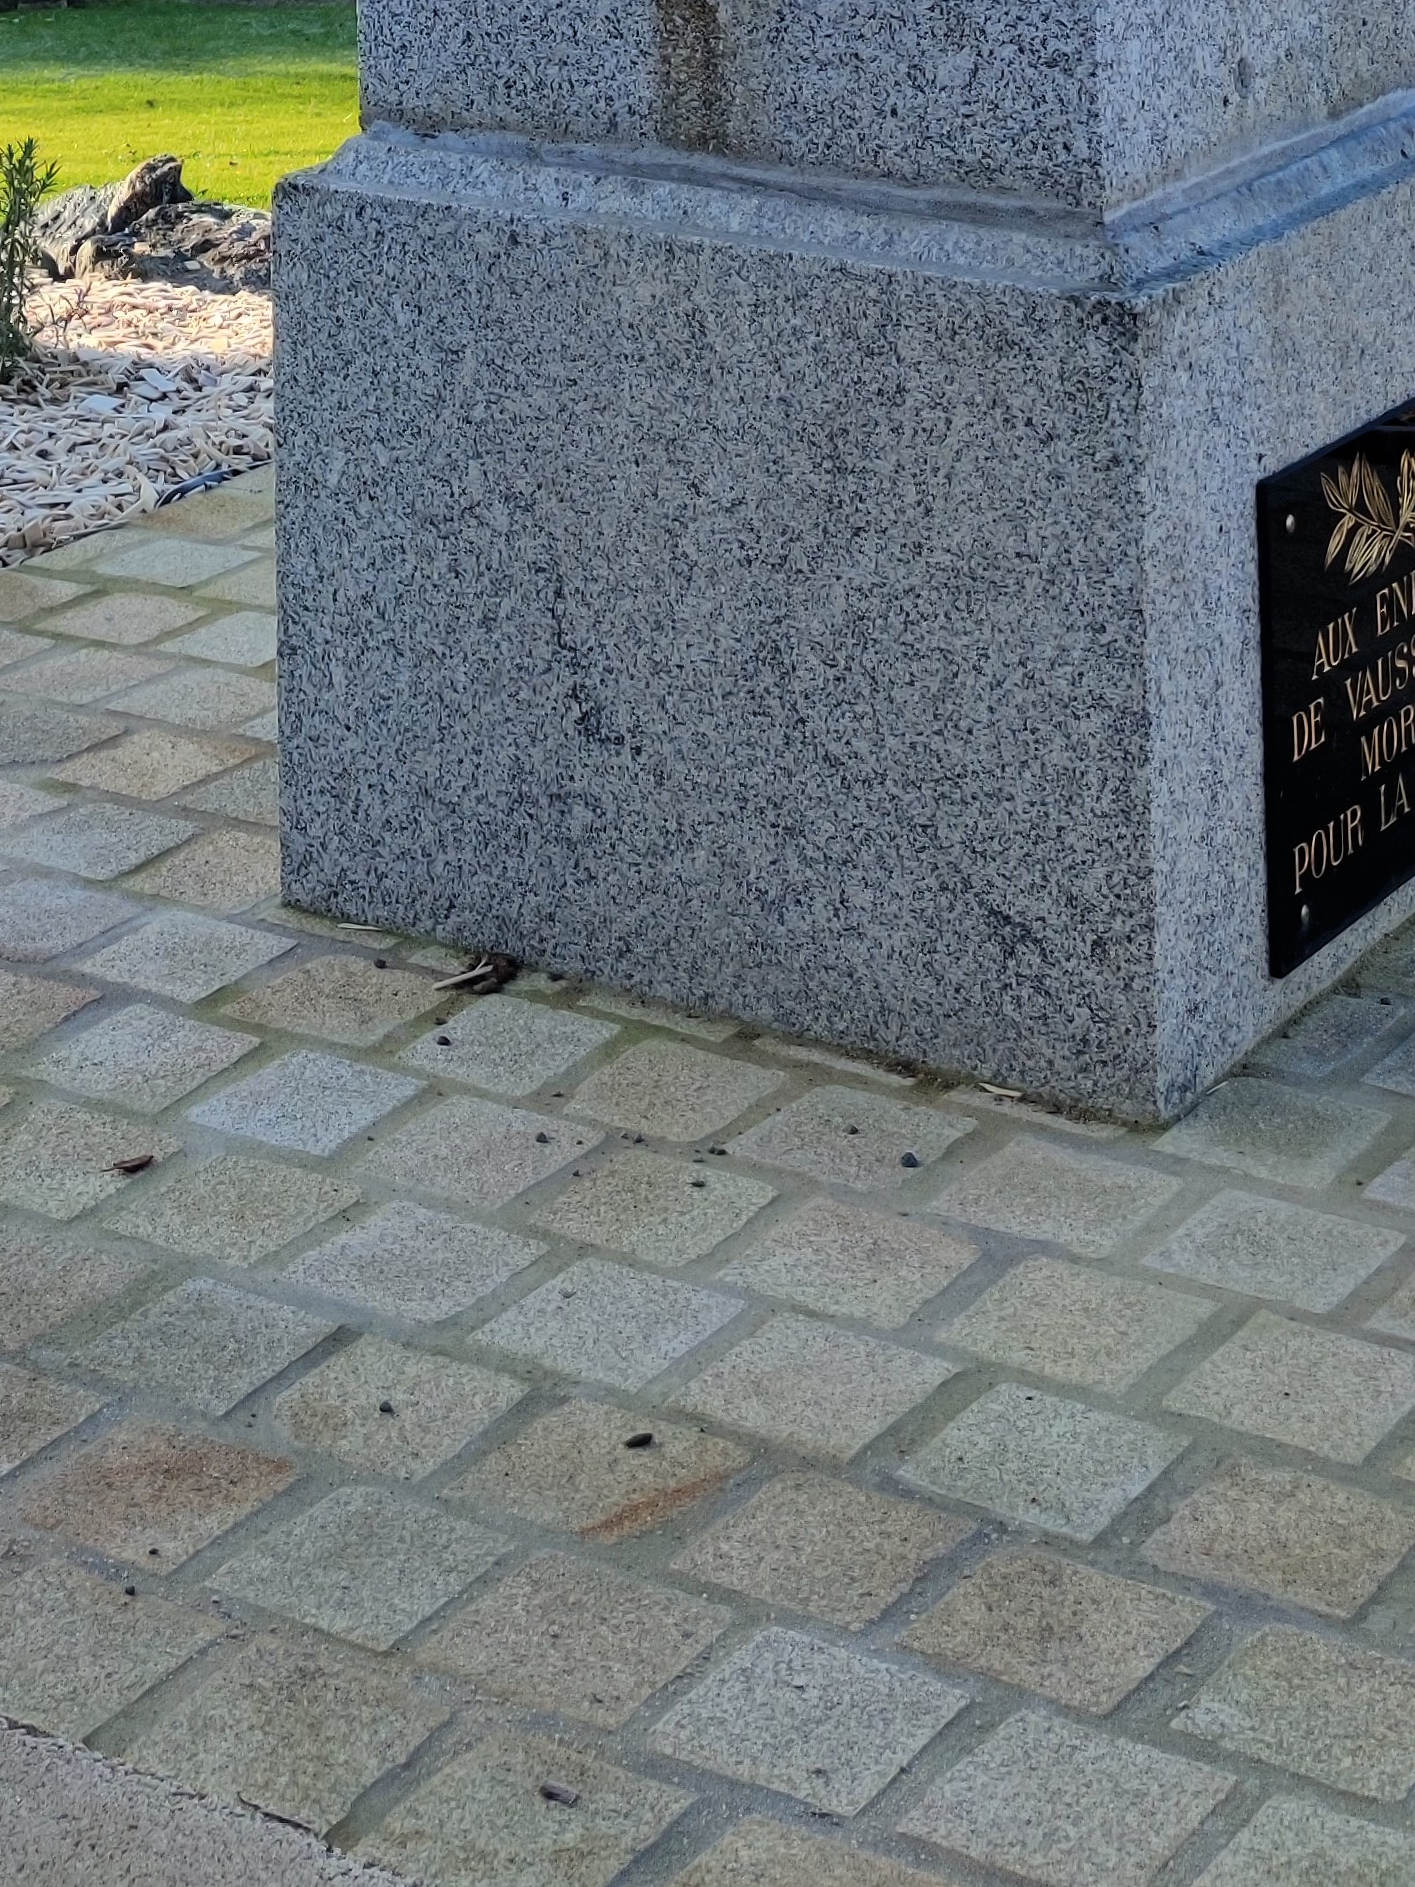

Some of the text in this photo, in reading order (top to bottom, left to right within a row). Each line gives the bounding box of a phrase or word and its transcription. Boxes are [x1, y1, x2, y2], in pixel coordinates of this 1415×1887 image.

[1311, 607, 1359, 681] AUX
[1291, 697, 1325, 763] DE
[1293, 804, 1364, 896] POUR
[1379, 774, 1411, 832] LA
